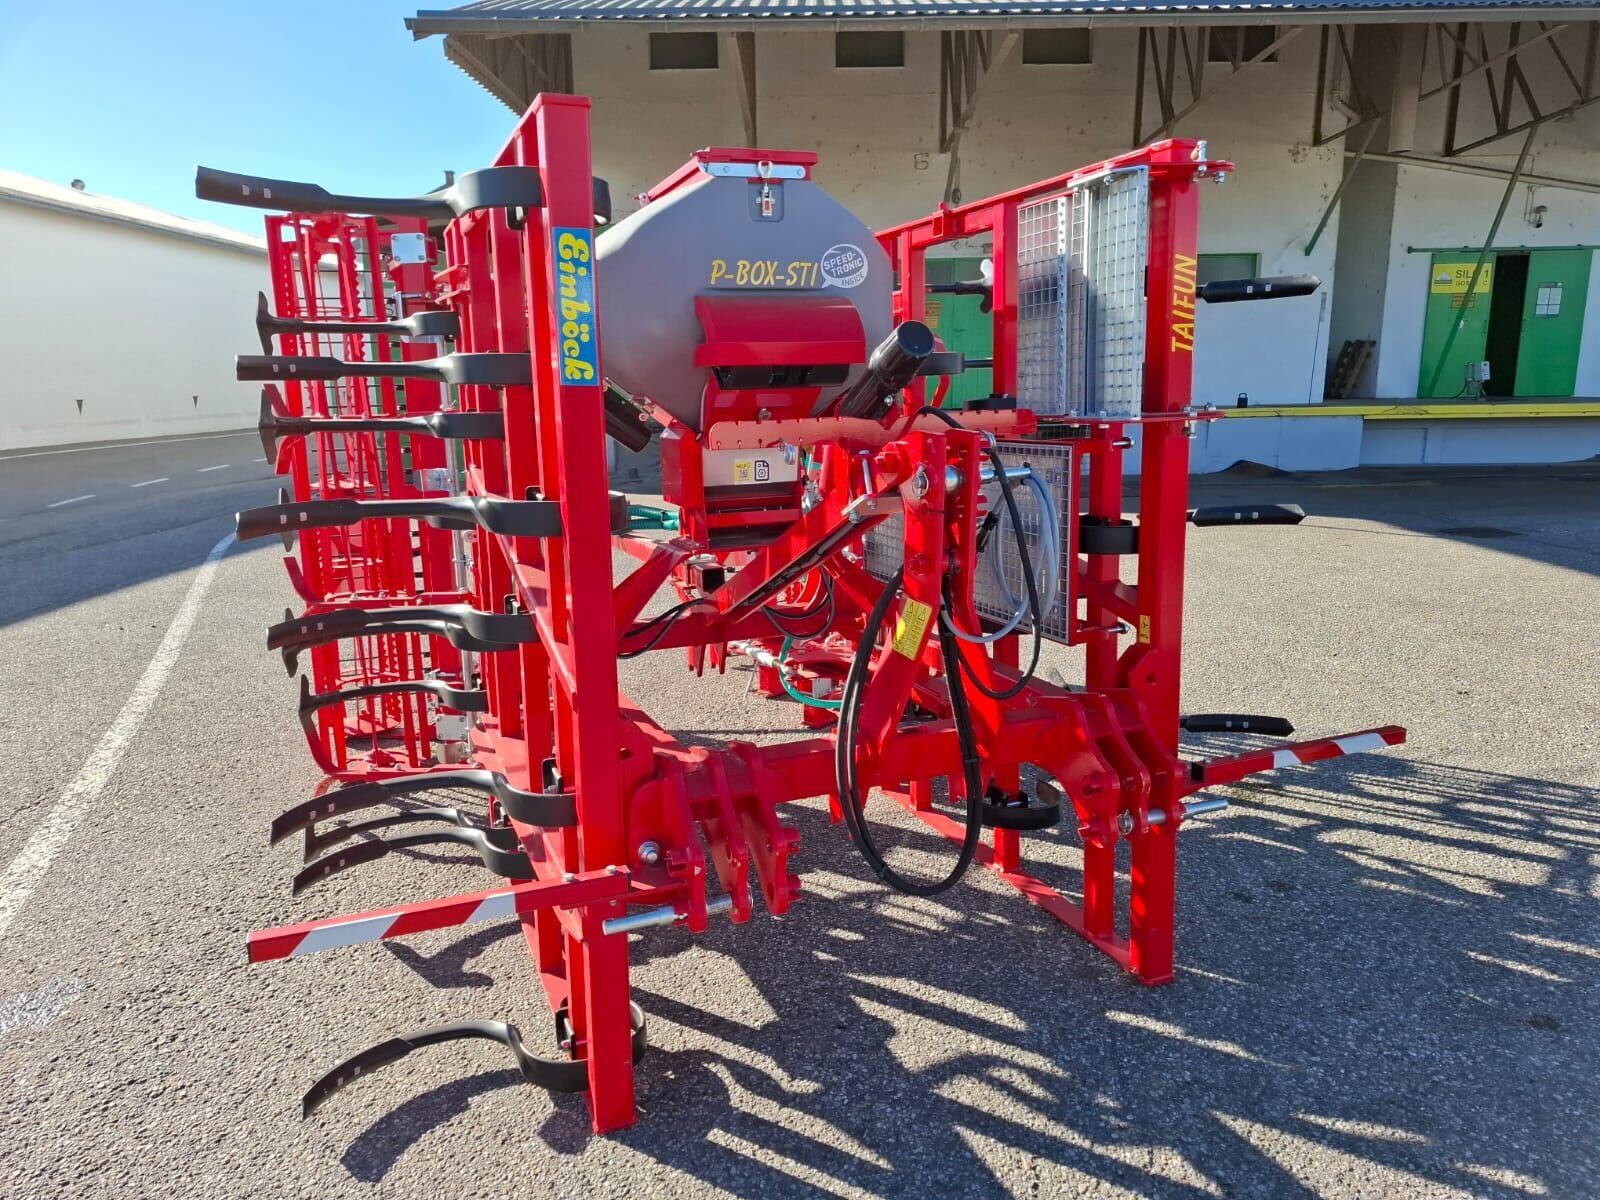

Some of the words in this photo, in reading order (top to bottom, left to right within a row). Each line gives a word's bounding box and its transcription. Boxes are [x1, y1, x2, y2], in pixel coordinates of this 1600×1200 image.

[823, 252, 857, 270] SPEED-
[830, 257, 863, 277] TRONIC
[710, 260, 818, 286] P-BOX-STI
[841, 271, 866, 286] INSIDE
[1455, 269, 1478, 279] SIL
[558, 232, 594, 380] Einböck
[1171, 253, 1197, 353] TAIFUN
